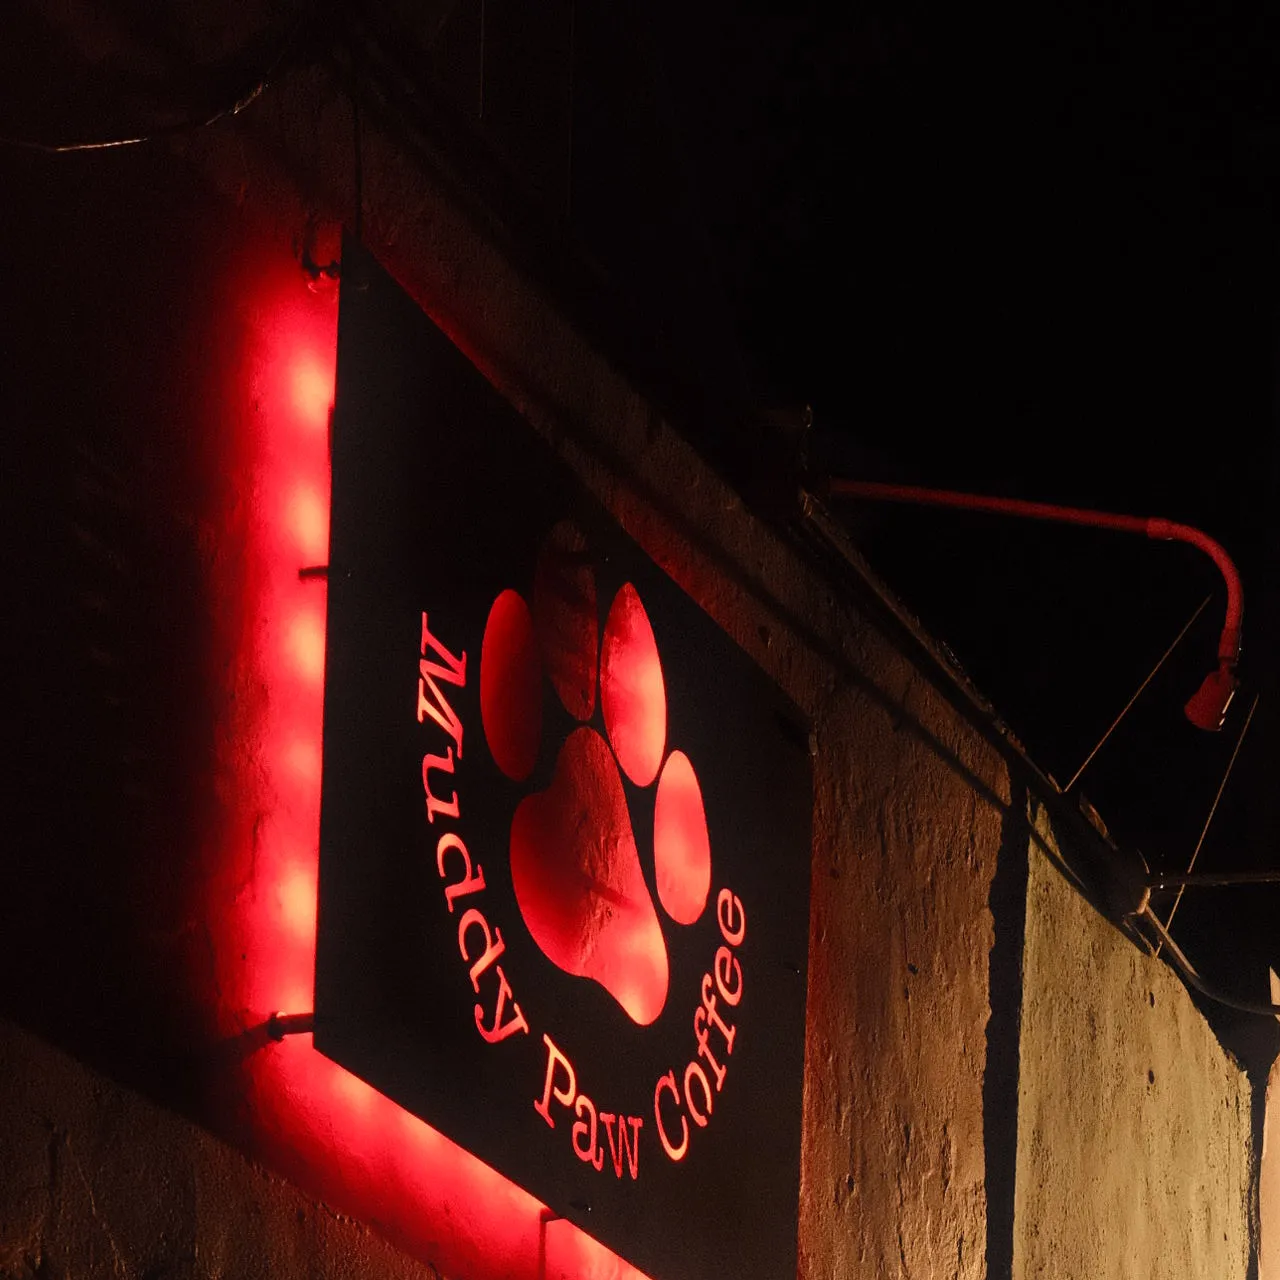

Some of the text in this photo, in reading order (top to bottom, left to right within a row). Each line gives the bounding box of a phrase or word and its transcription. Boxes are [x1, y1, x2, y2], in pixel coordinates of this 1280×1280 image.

[415, 610, 746, 1181] Muddy Paw Coffee
